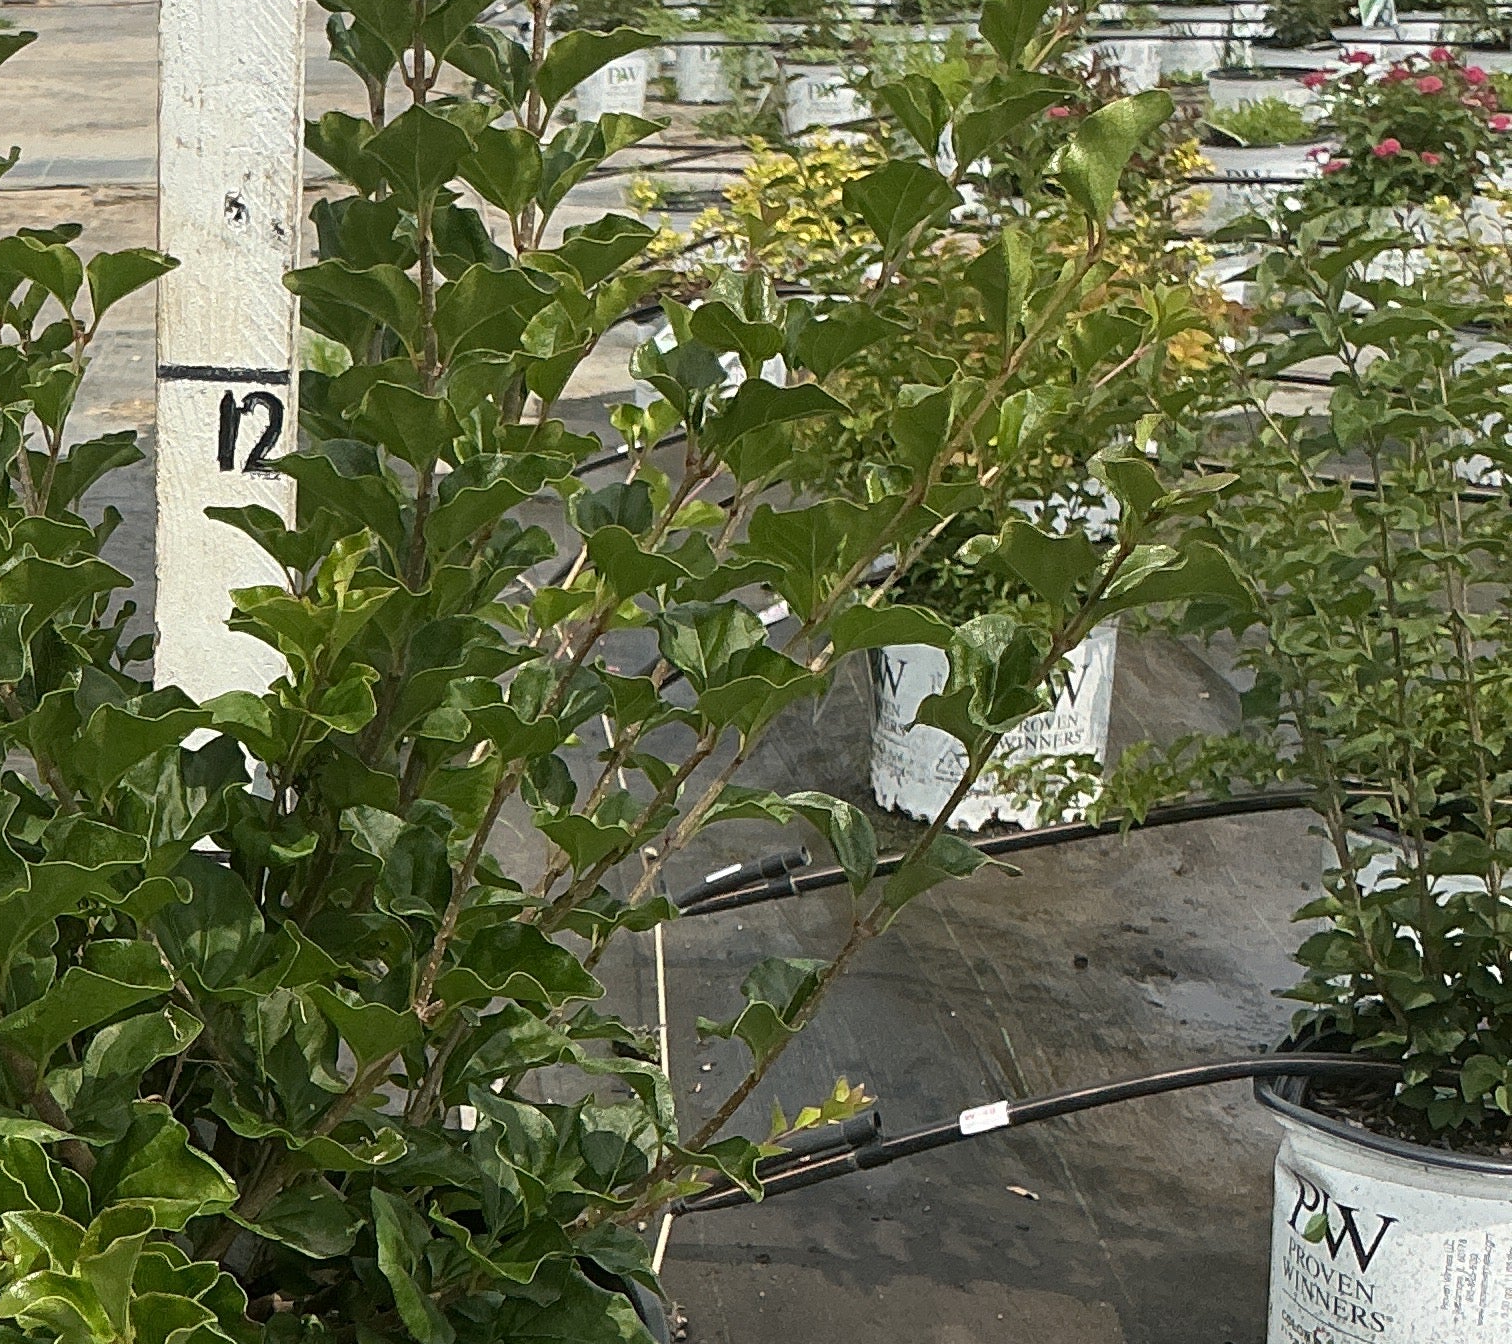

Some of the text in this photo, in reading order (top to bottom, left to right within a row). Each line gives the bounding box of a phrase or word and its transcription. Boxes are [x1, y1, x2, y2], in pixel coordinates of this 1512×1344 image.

[217, 389, 284, 473] 12
[1018, 714, 1080, 734] ROVEN
[1287, 1169, 1399, 1274] PW
[1283, 1255, 1385, 1332] WINNERS
[1288, 1236, 1375, 1305] PROVEN
